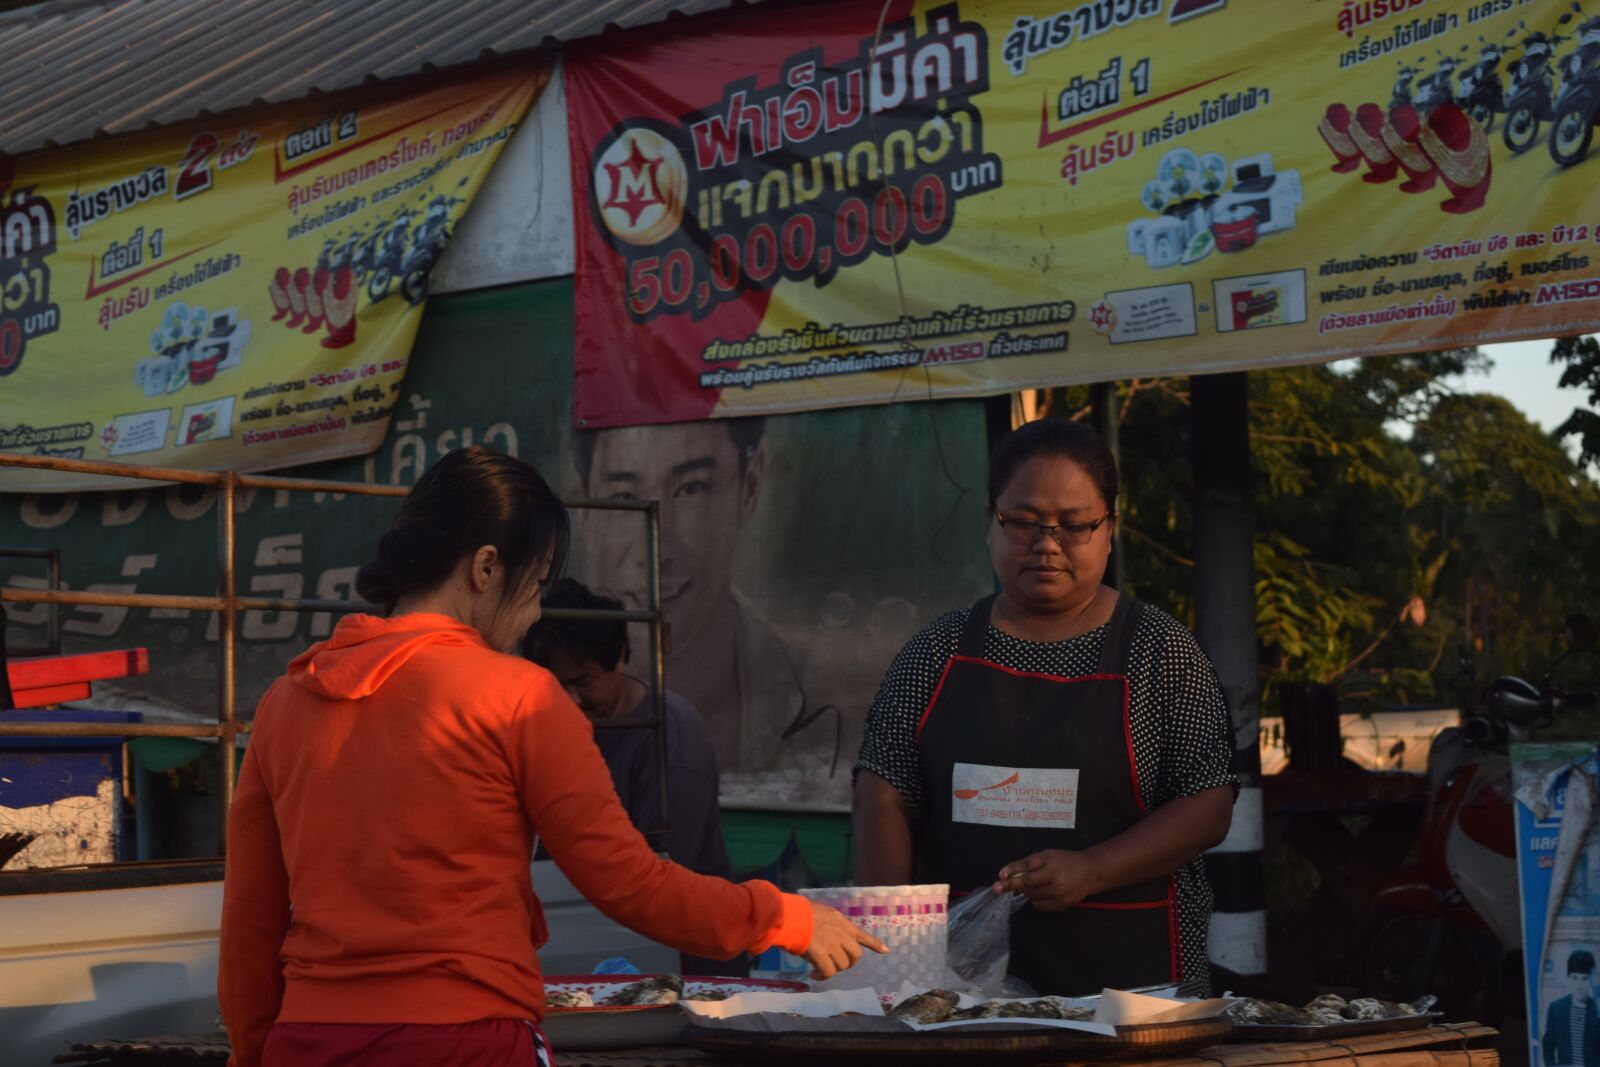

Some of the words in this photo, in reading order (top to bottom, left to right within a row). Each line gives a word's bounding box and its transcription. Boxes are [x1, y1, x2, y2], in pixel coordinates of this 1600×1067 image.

[1004, 0, 1159, 71] ลุ้นรางว
[1340, 12, 1458, 68] เครื่องใช้ไฟฟ้า
[1058, 56, 1121, 121] ต่อที่
[1130, 58, 1150, 97] 1
[337, 111, 358, 141] 2
[1061, 130, 1135, 187] ลุ้นรับ
[1142, 87, 1270, 147] เครื่องใช้ไฟฟ้า
[66, 165, 167, 237] ลุ้นรางวัล
[175, 133, 220, 200] 2
[699, 98, 974, 229] แจกมากกว่า
[149, 228, 164, 259] 1
[630, 174, 947, 315] 50,000,000
[951, 160, 996, 193] บาท
[1321, 281, 1367, 303] พร้อม
[1521, 250, 1589, 276] เบอร์โทร
[25, 308, 57, 334] บาท
[99, 288, 150, 331] ลุ้นรับ
